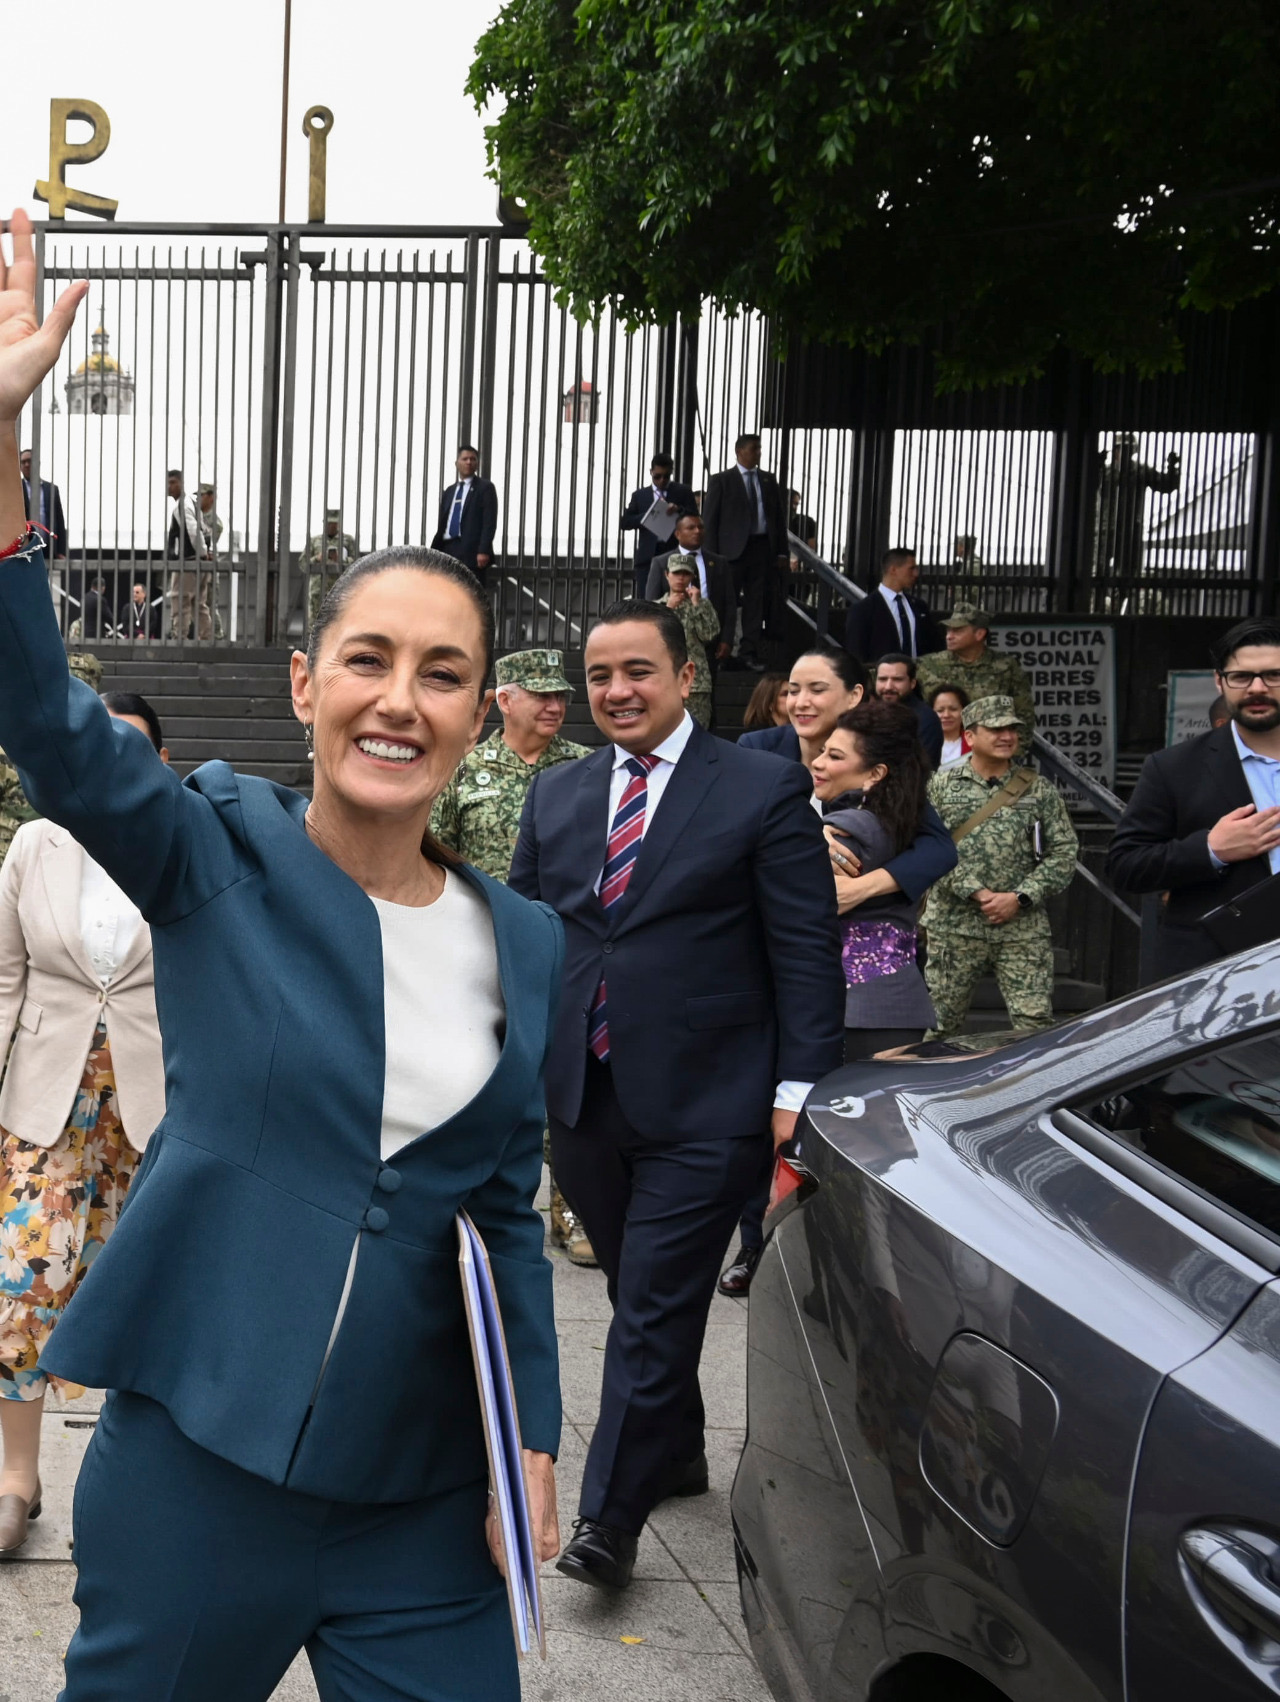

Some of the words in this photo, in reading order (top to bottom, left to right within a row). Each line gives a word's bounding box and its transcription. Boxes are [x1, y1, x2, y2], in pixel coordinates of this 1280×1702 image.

[986, 631, 999, 648] E
[1004, 630, 1106, 648] SOLICITA
[1004, 650, 1100, 667] RSONAL
[1027, 670, 1096, 687] BRES
[1034, 690, 1102, 707] JERES
[1077, 712, 1108, 727] AL:
